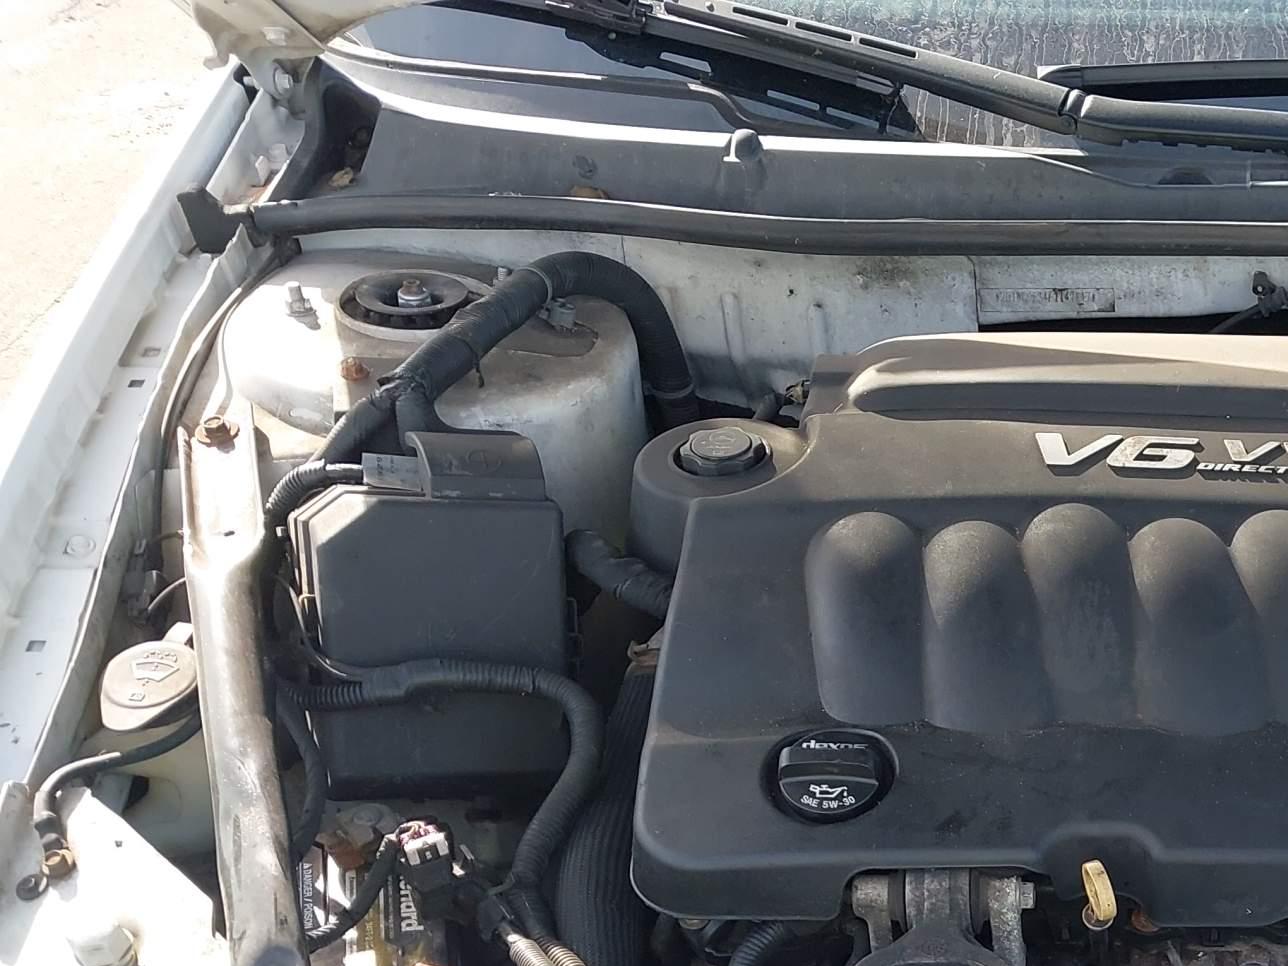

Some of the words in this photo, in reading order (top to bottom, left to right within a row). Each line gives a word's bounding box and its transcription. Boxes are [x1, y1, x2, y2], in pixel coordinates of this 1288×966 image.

[1035, 433, 1200, 469] V6
[801, 795, 820, 808] SAE
[821, 796, 856, 809] 5W-30
[303, 869, 313, 897] DANGER
[303, 903, 313, 929] POISON
